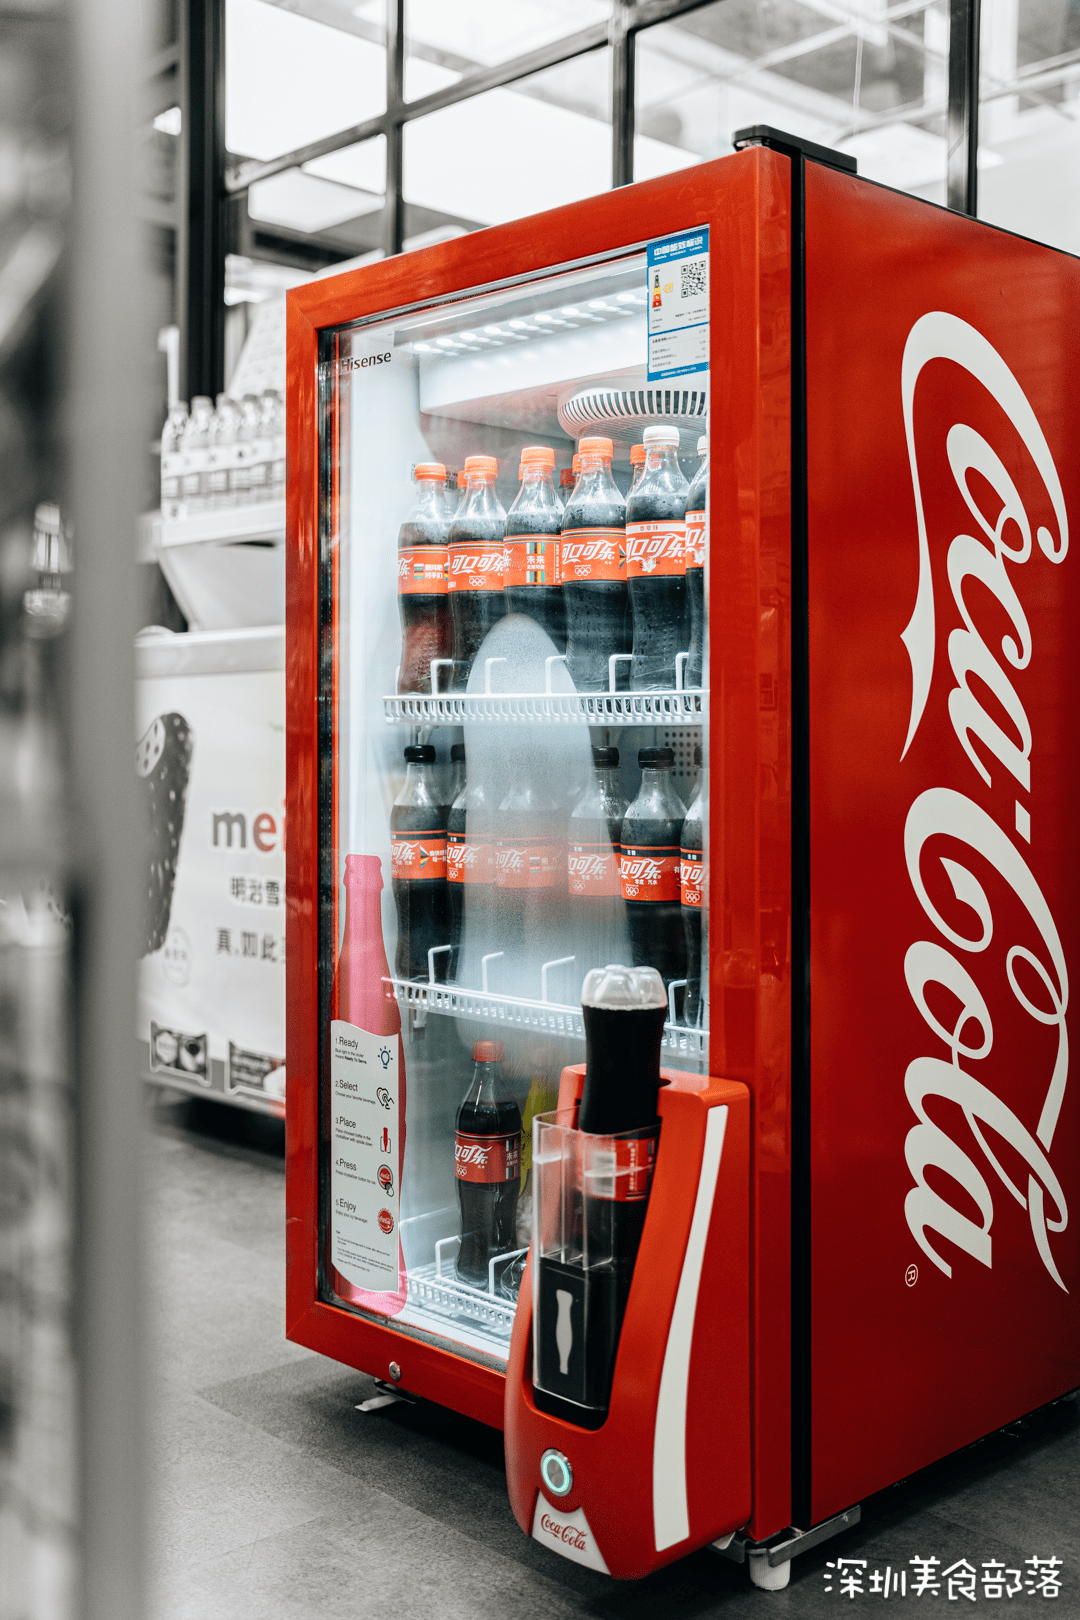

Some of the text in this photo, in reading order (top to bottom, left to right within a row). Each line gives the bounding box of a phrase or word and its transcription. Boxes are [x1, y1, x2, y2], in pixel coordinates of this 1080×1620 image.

[341, 352, 391, 371] Hisense
[526, 555, 545, 564] 未来
[900, 311, 1069, 1296] Coca-Cola
[540, 1513, 587, 1552] Coca-Cola
